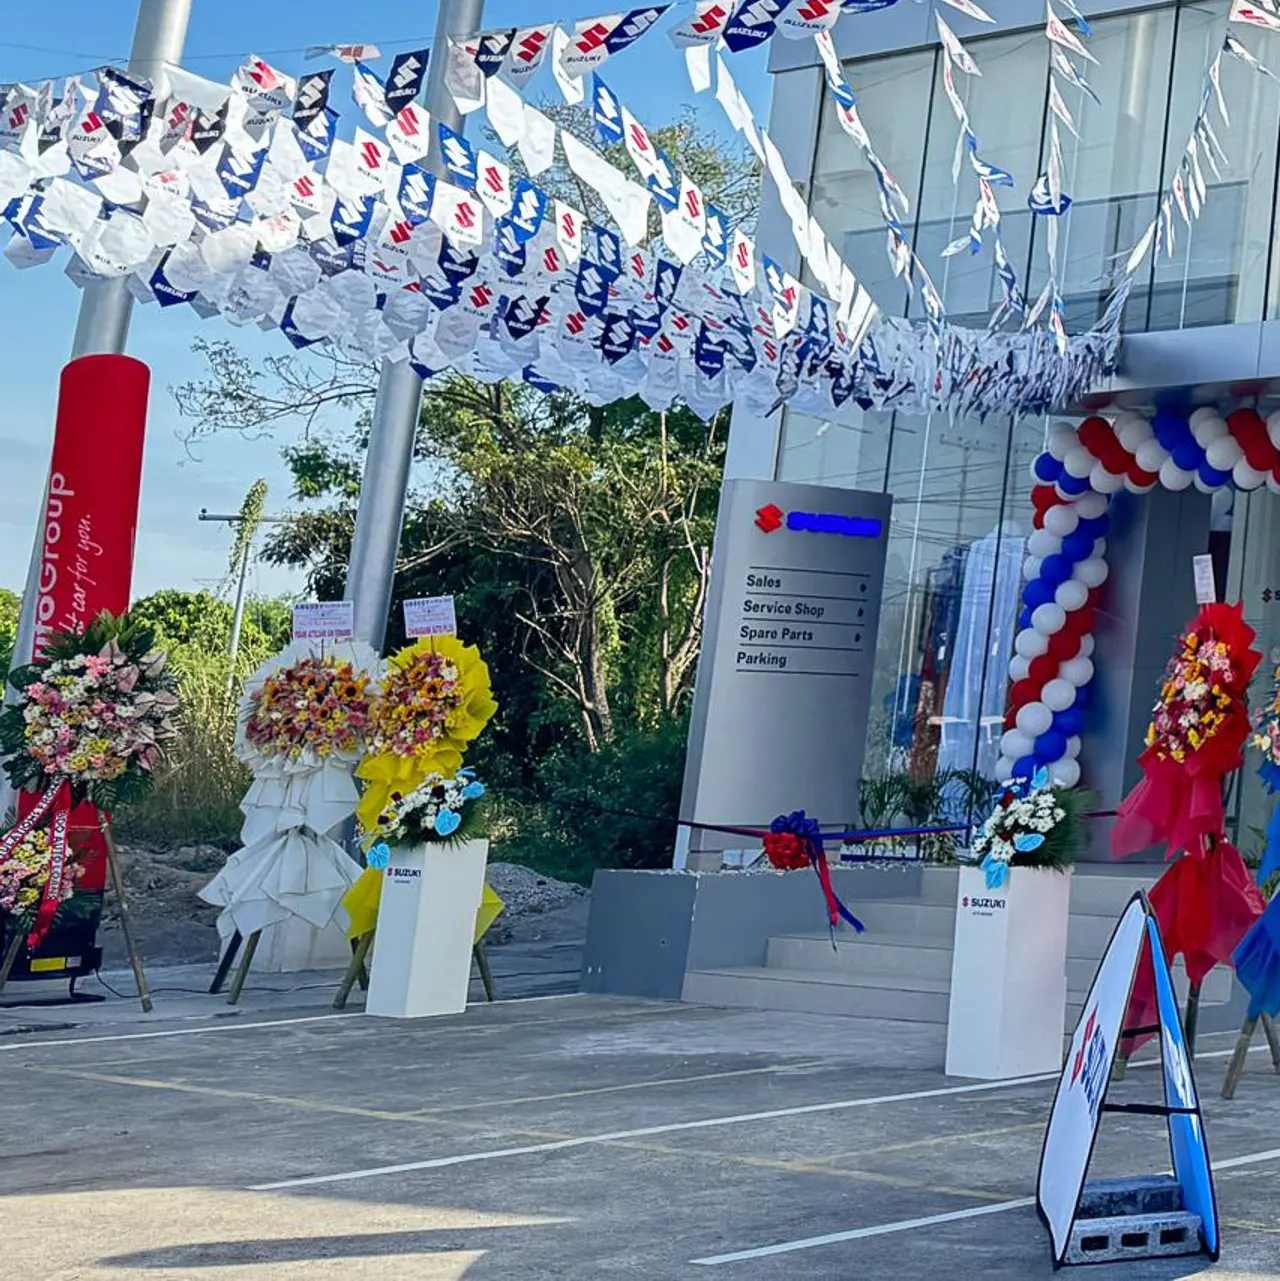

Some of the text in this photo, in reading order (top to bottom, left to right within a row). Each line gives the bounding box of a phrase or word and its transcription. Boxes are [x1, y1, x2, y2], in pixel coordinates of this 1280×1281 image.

[727, 26, 768, 39] SUZUKI
[784, 18, 826, 30] SUZUKI
[77, 513, 104, 556] you.
[66, 554, 97, 586] for
[746, 574, 782, 589] Sales
[71, 585, 88, 613] car
[743, 599, 825, 619] Service Shop
[740, 625, 814, 642] Spare Parts
[736, 651, 788, 669] Parking
[53, 835, 66, 864] AUTO
[971, 897, 1006, 908] SUZUKI
